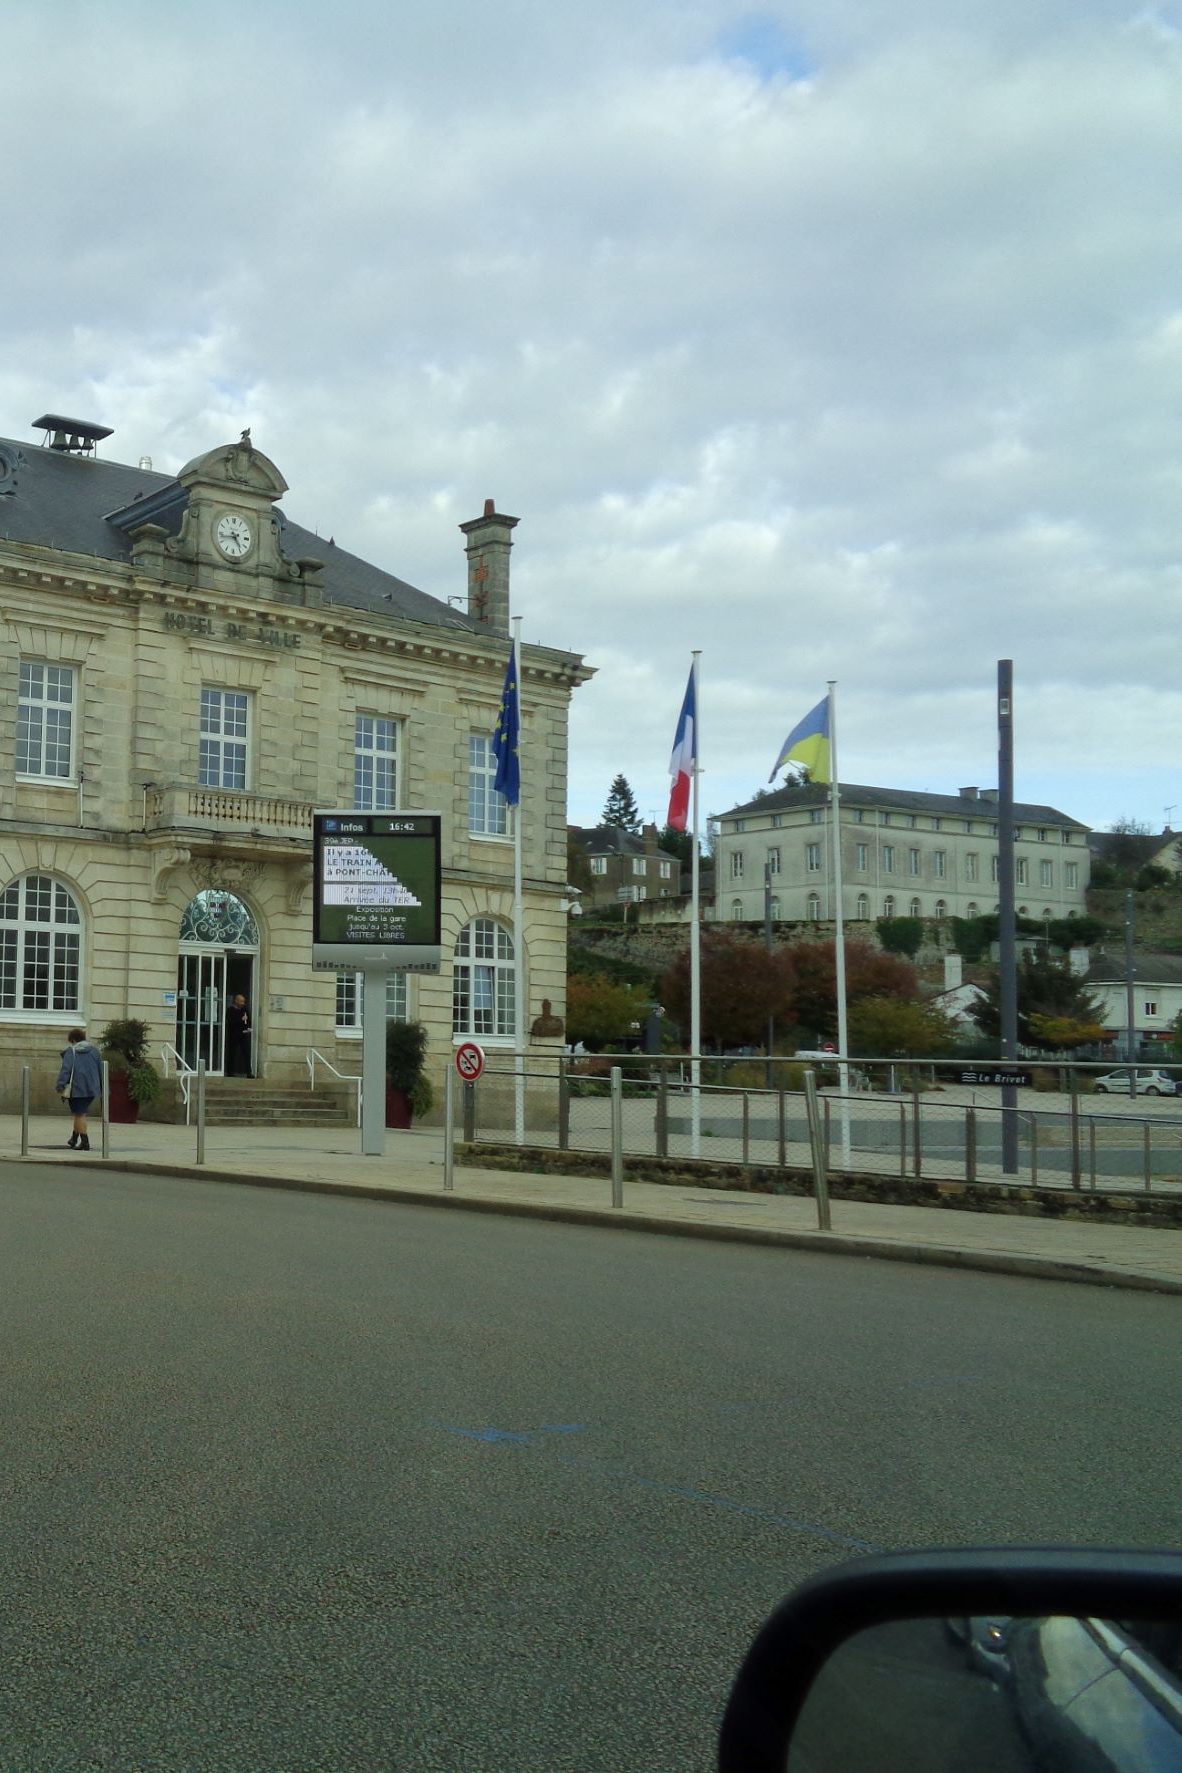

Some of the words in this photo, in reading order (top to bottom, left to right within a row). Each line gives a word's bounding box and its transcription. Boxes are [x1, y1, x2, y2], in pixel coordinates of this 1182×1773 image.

[340, 823, 364, 832] Infos
[389, 822, 415, 831] 16:42
[327, 858, 338, 866] LE
[341, 858, 372, 866] TRAIN
[378, 895, 389, 904] du
[356, 906, 394, 914] Exposition
[347, 914, 366, 922] Place
[369, 914, 378, 922] de
[380, 914, 388, 922] la
[389, 916, 407, 924] gare
[346, 932, 376, 940] VISITES
[379, 932, 406, 940] LIBRES
[978, 1073, 991, 1083] Le
